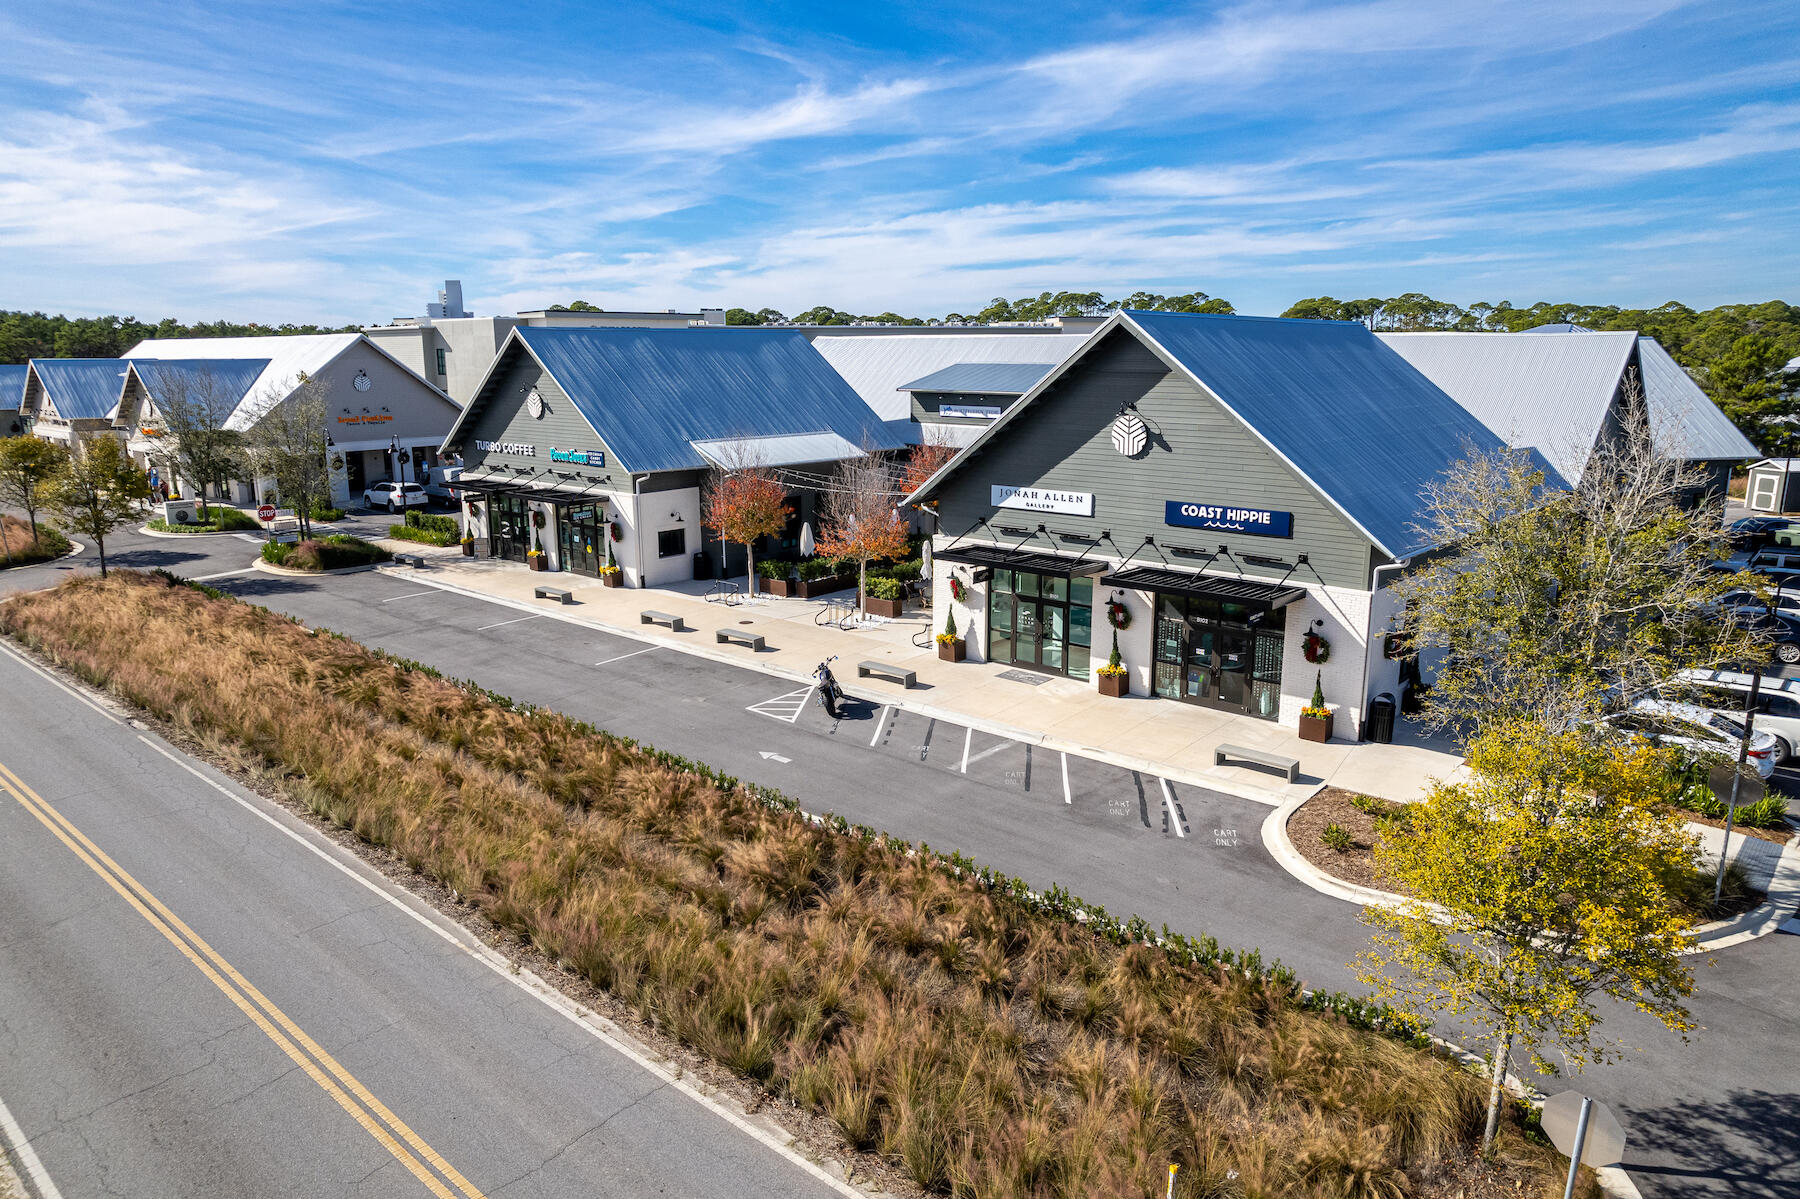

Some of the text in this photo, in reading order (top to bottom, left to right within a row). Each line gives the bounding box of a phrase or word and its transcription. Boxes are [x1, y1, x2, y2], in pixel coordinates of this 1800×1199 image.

[475, 440, 534, 456] TURBO COFFEE
[999, 488, 1084, 504] JONAH ALLEN
[1181, 504, 1270, 524] COAST HIPPIE
[1214, 829, 1236, 837] CART
[1216, 838, 1237, 846] ONLY
